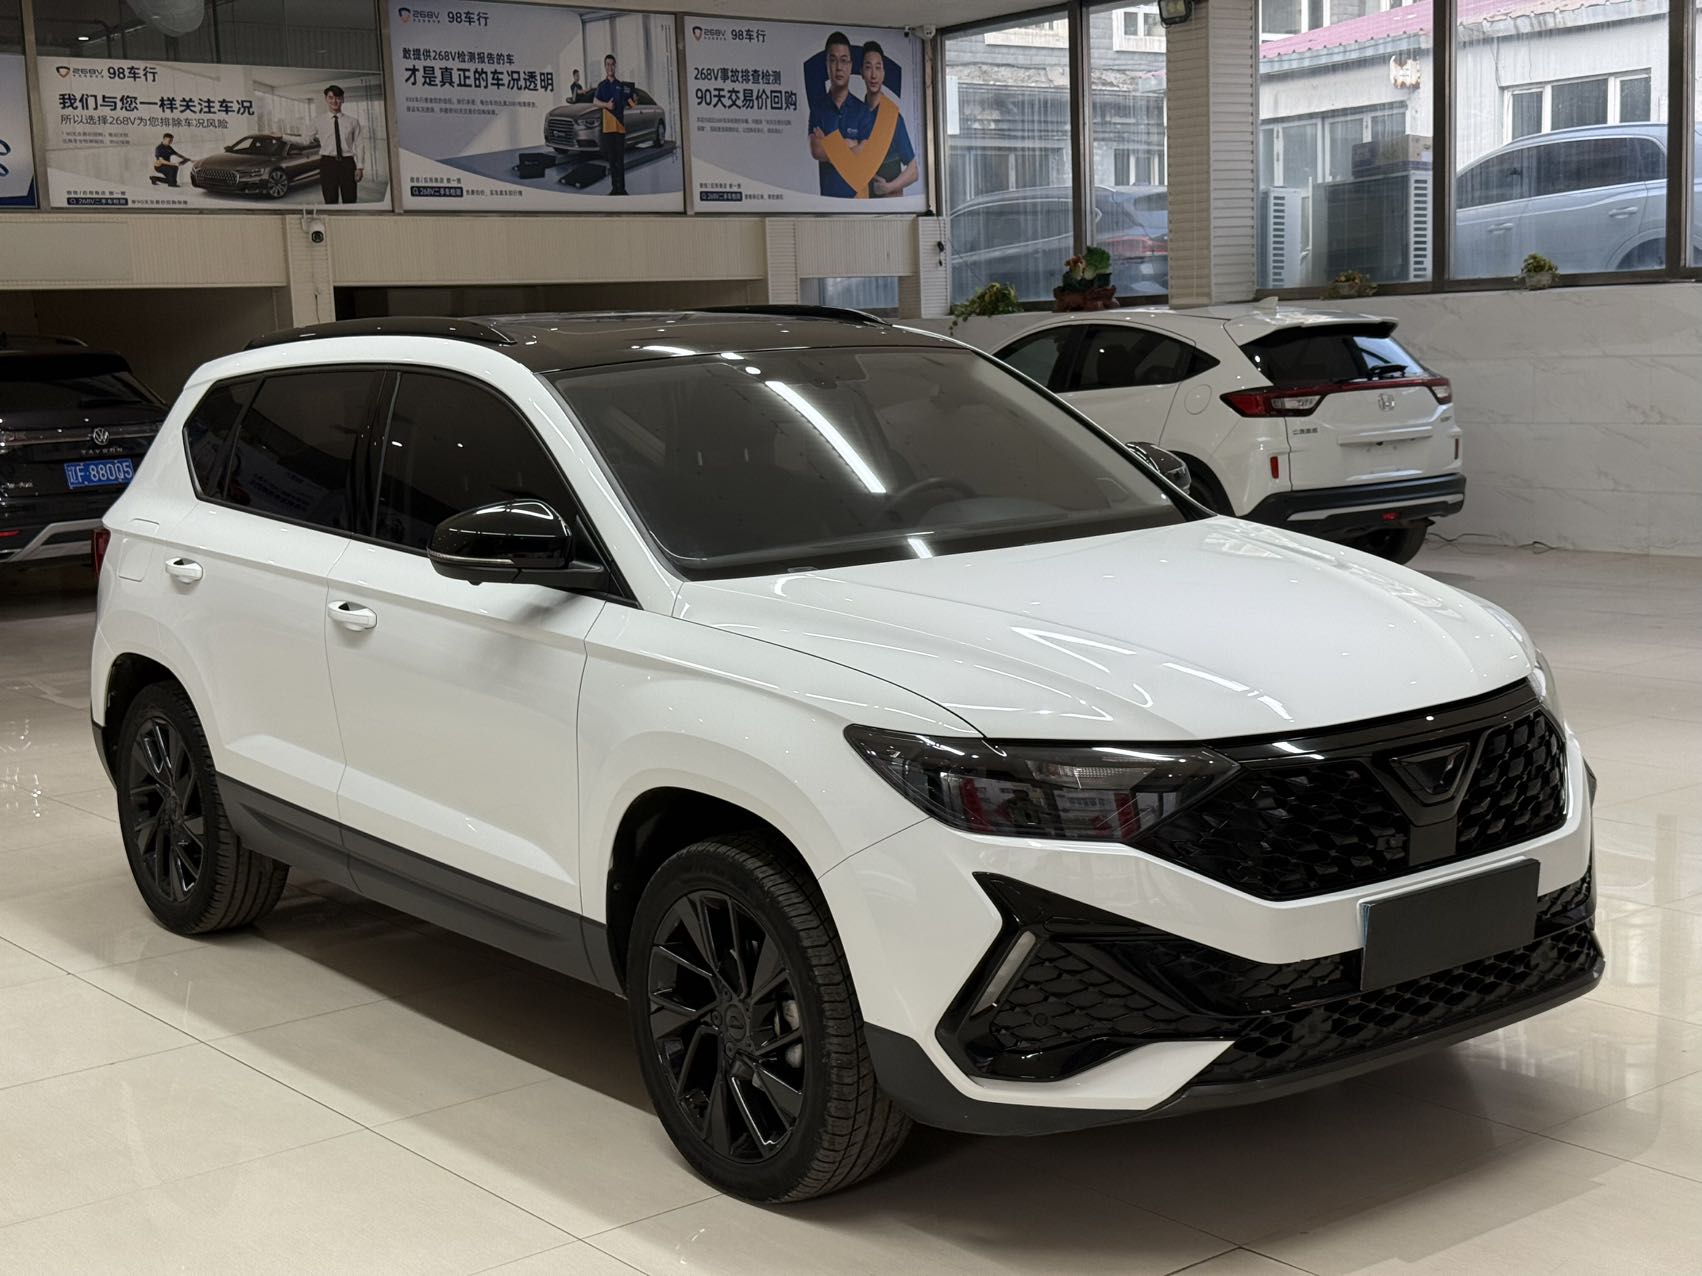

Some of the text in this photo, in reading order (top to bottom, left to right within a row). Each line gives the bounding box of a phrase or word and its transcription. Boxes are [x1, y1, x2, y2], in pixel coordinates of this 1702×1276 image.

[412, 11, 441, 19] 268V
[447, 11, 490, 27] 98车行
[731, 28, 767, 43] 98车行
[402, 47, 515, 66] 敢提供268V检测报告的车
[107, 65, 158, 83] 98车行
[404, 64, 555, 93] 才是真正的车况透明
[694, 67, 782, 86] 268V事故排查检测
[58, 93, 256, 116] 我们与您一样关注车况
[695, 87, 798, 111] 90天交易价回购
[60, 114, 230, 130] 所以选择268V为您排除车况风险
